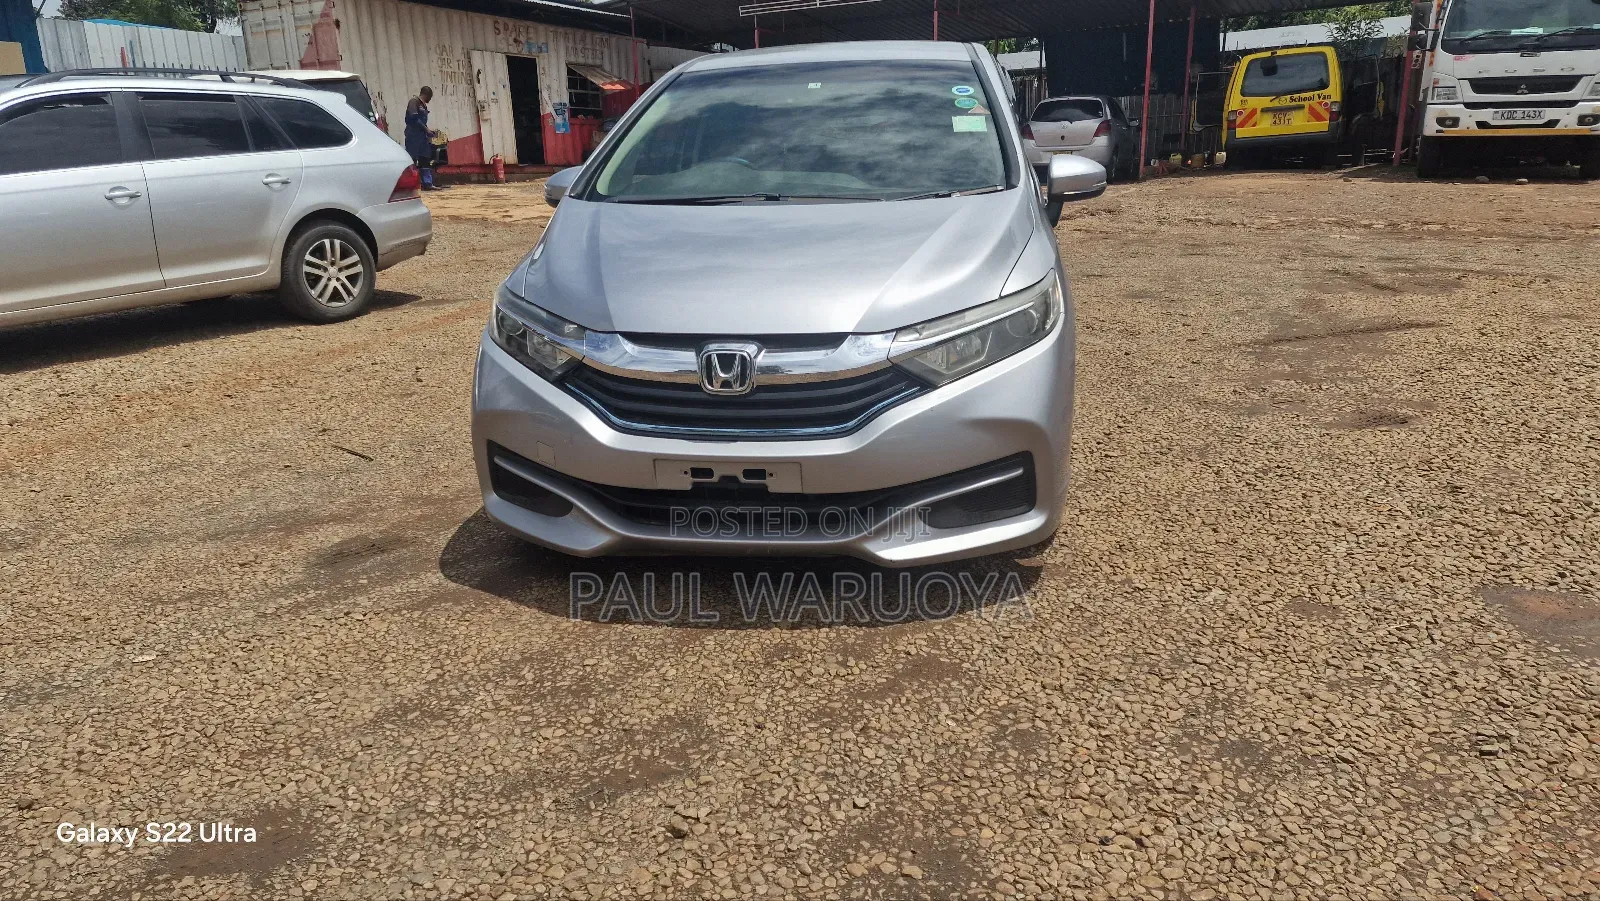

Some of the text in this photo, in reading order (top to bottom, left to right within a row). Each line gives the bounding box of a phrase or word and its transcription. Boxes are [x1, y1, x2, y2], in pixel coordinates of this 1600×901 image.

[1289, 93, 1332, 103] School Van
[1500, 110, 1543, 119] KDC 143X
